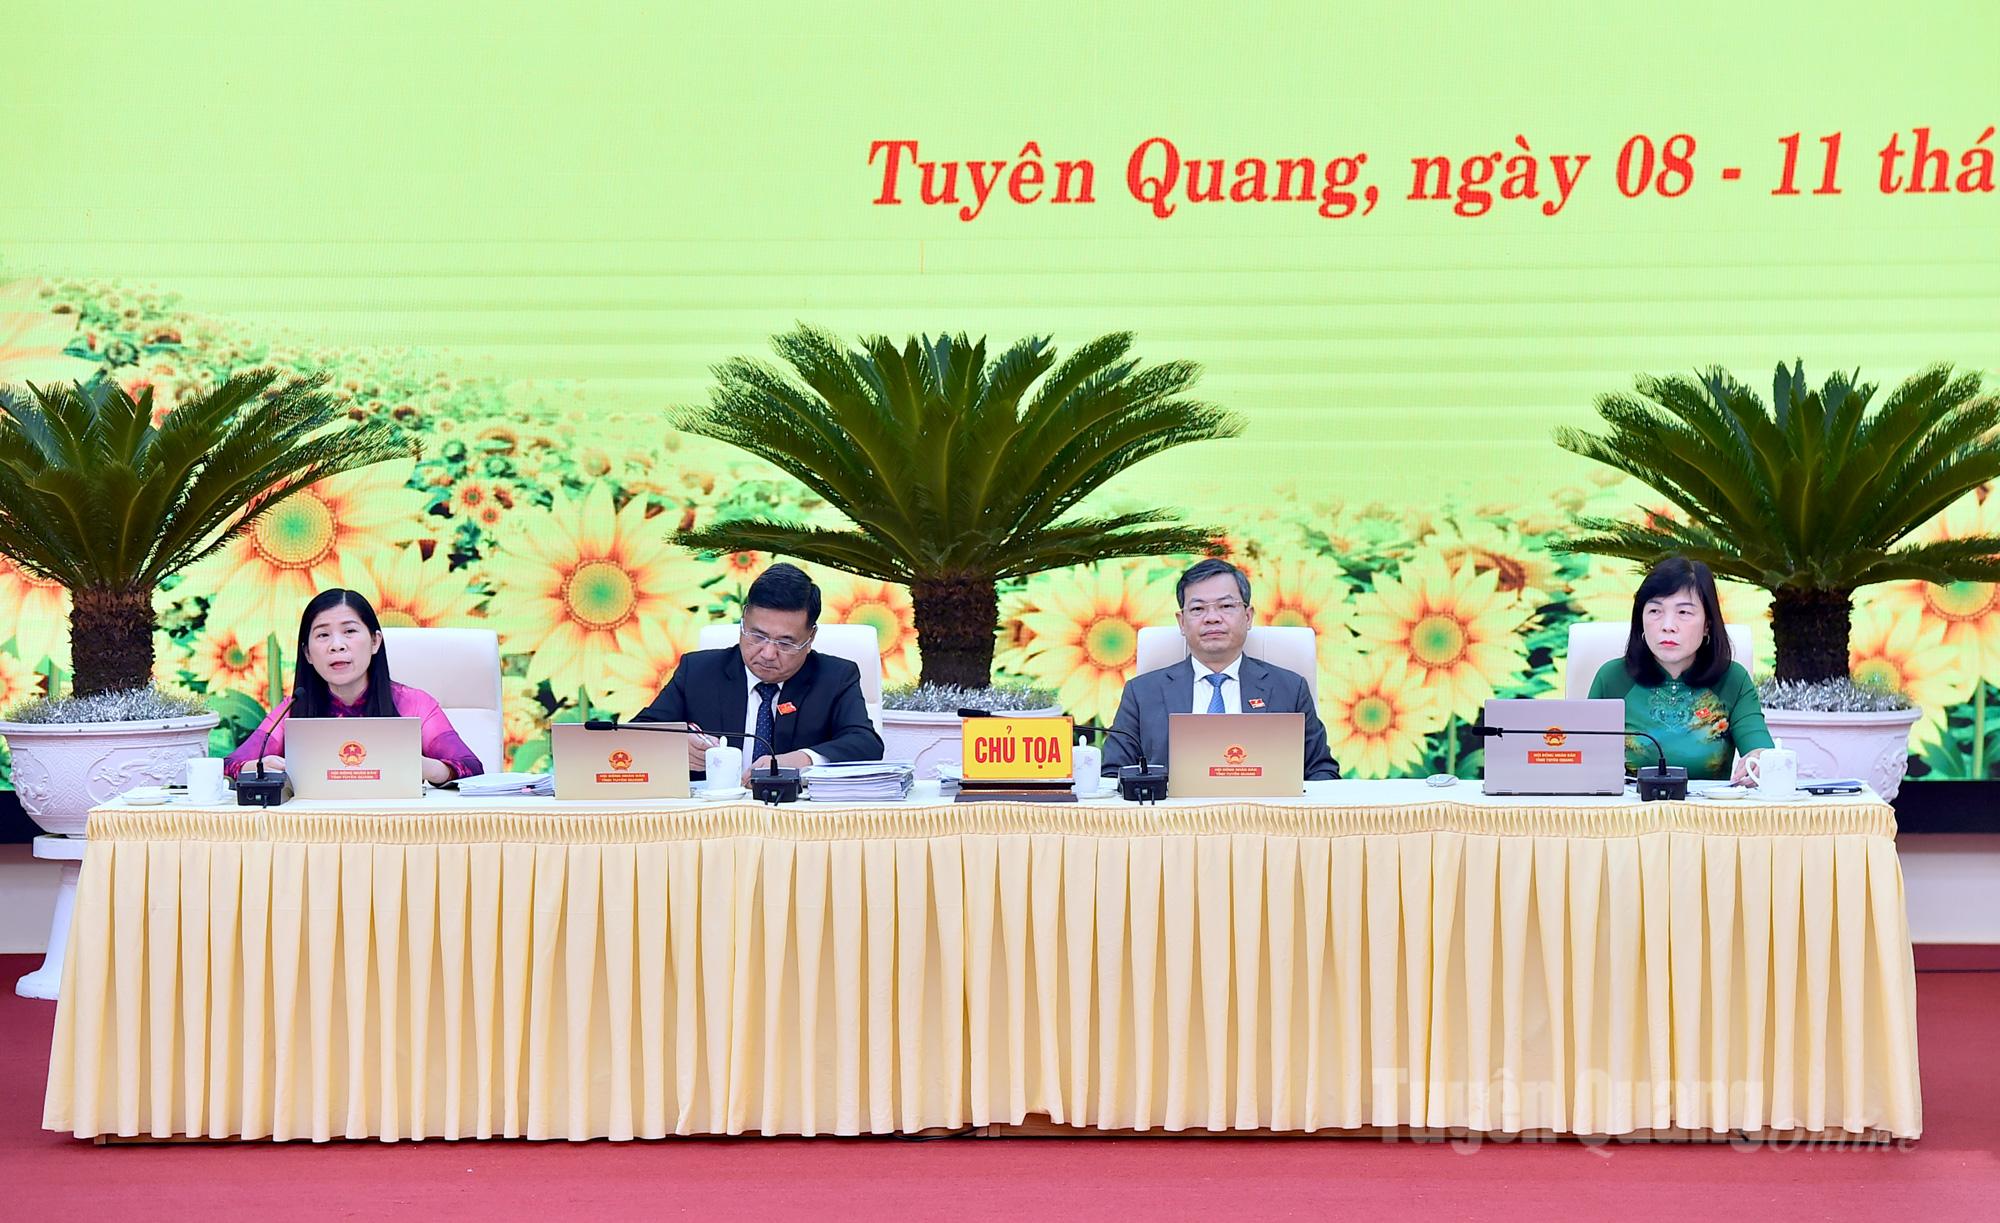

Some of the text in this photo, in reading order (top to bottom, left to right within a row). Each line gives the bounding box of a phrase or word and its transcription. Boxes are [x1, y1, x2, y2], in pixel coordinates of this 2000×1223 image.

[868, 126, 1996, 223] Tuyên Quang, ngày 08 - 11 thá
[975, 725, 1062, 769] CHỦ TỌA
